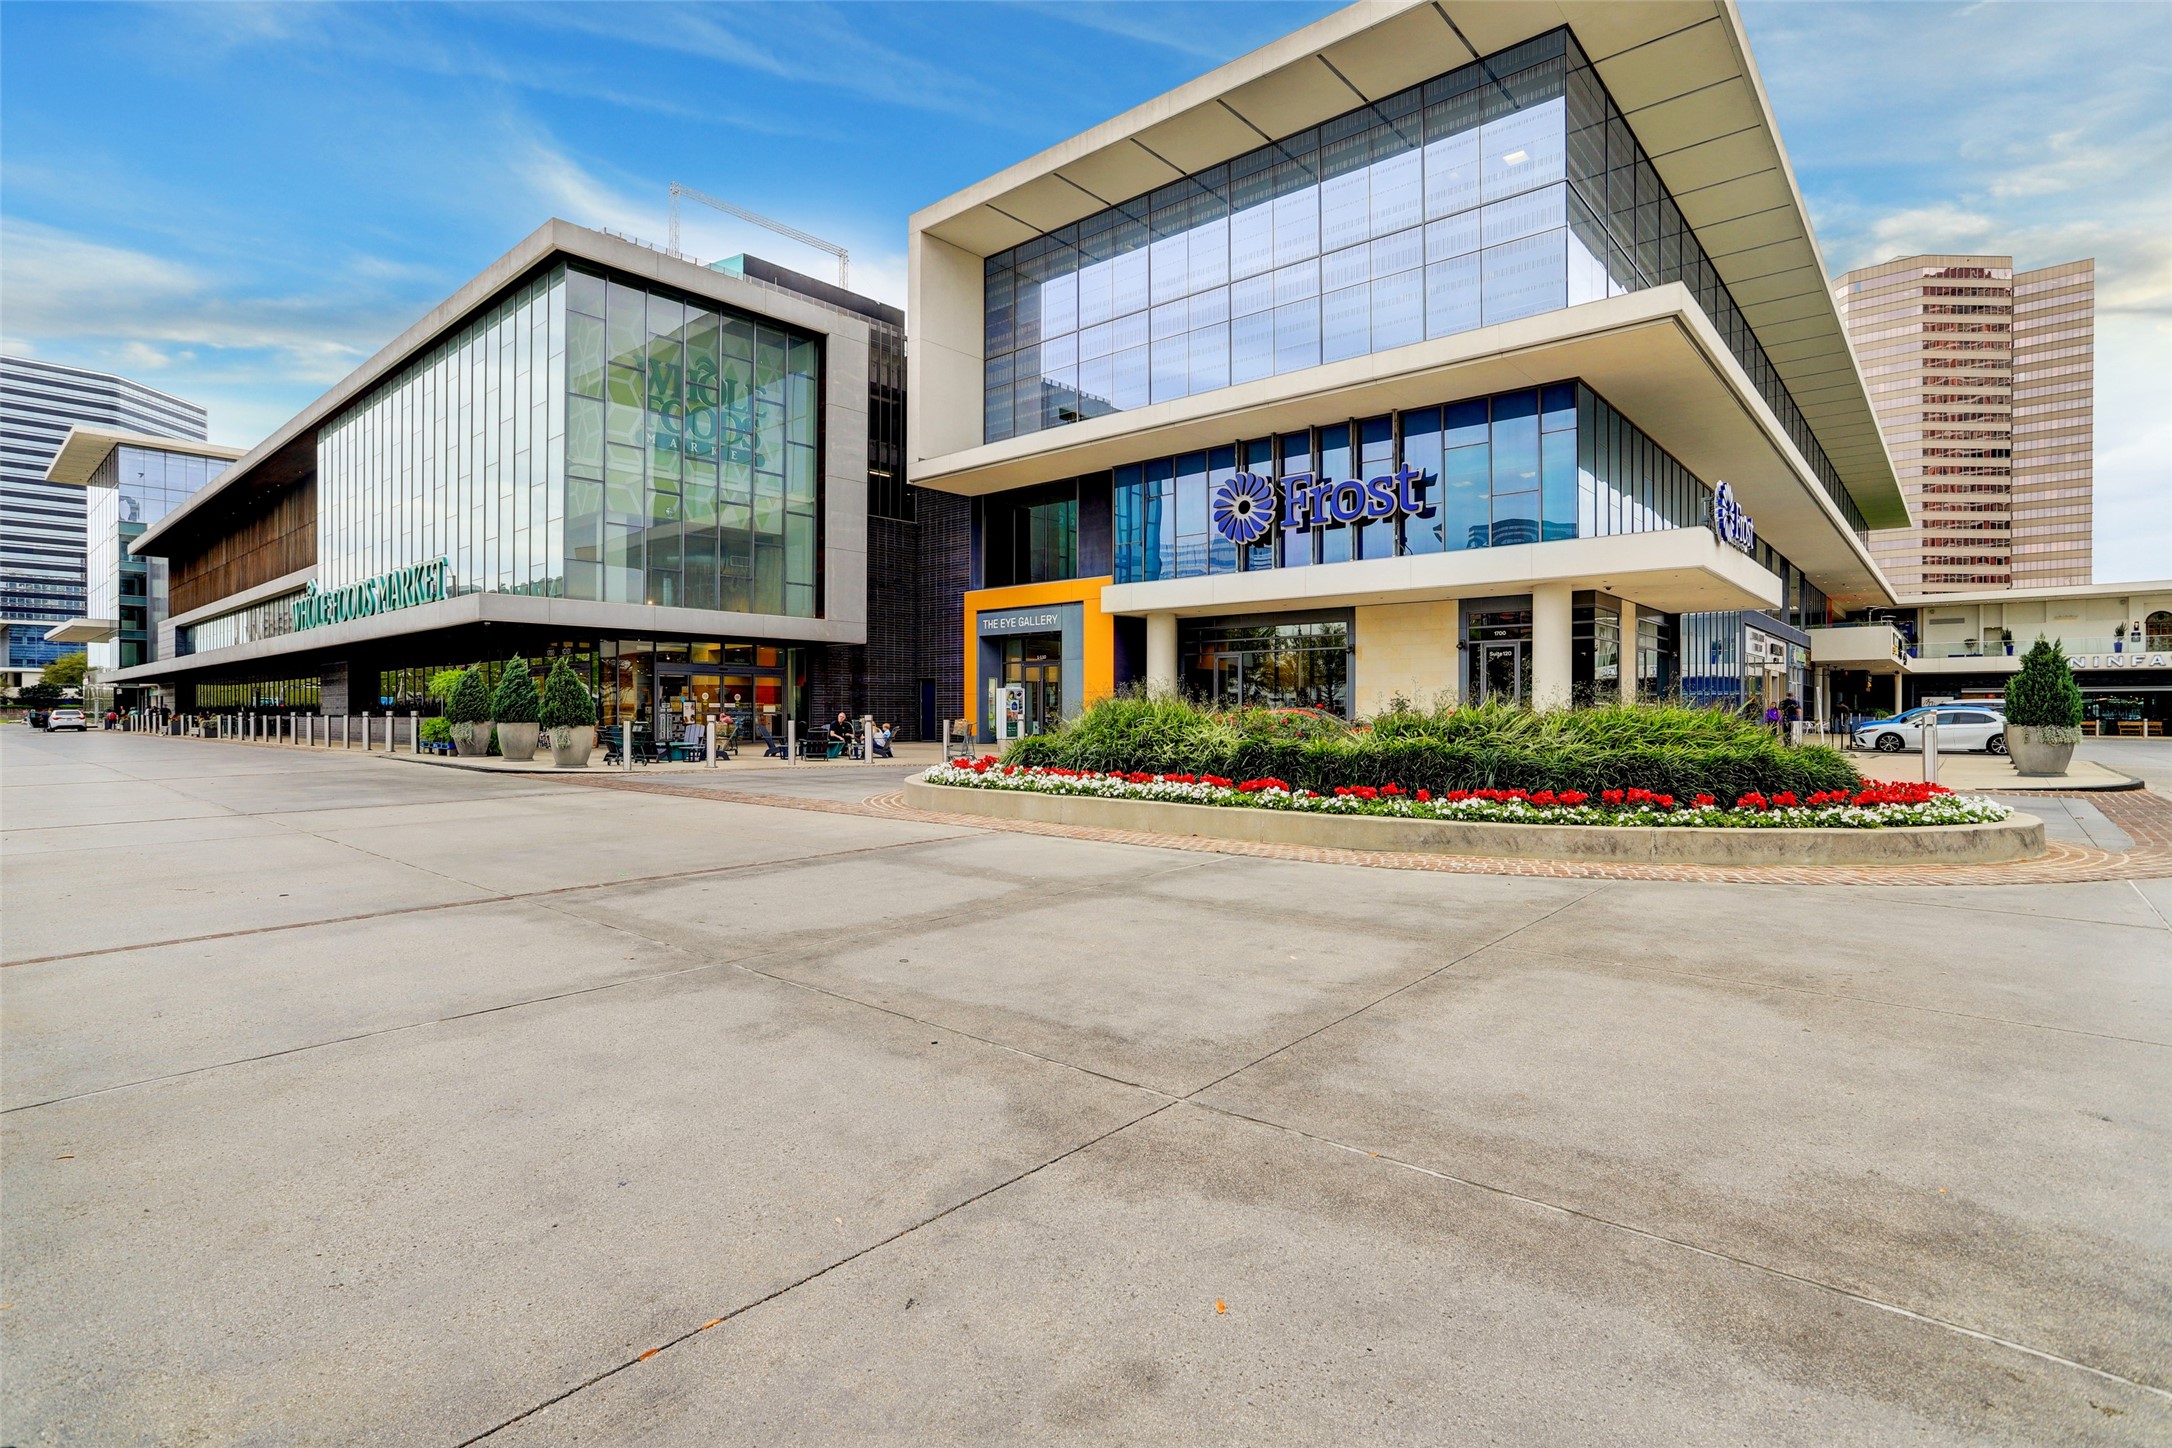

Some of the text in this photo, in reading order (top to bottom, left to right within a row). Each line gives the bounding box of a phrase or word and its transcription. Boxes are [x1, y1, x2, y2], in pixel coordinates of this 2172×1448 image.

[633, 355, 767, 418] WHOLE
[641, 394, 761, 450] FOODS
[646, 432, 751, 461] MARKE
[1281, 462, 1423, 530] Frost
[1732, 501, 1754, 549] Frost
[291, 556, 448, 633] WHOLE FOODS MARKET
[983, 614, 1058, 630] THE EYE GALLERY
